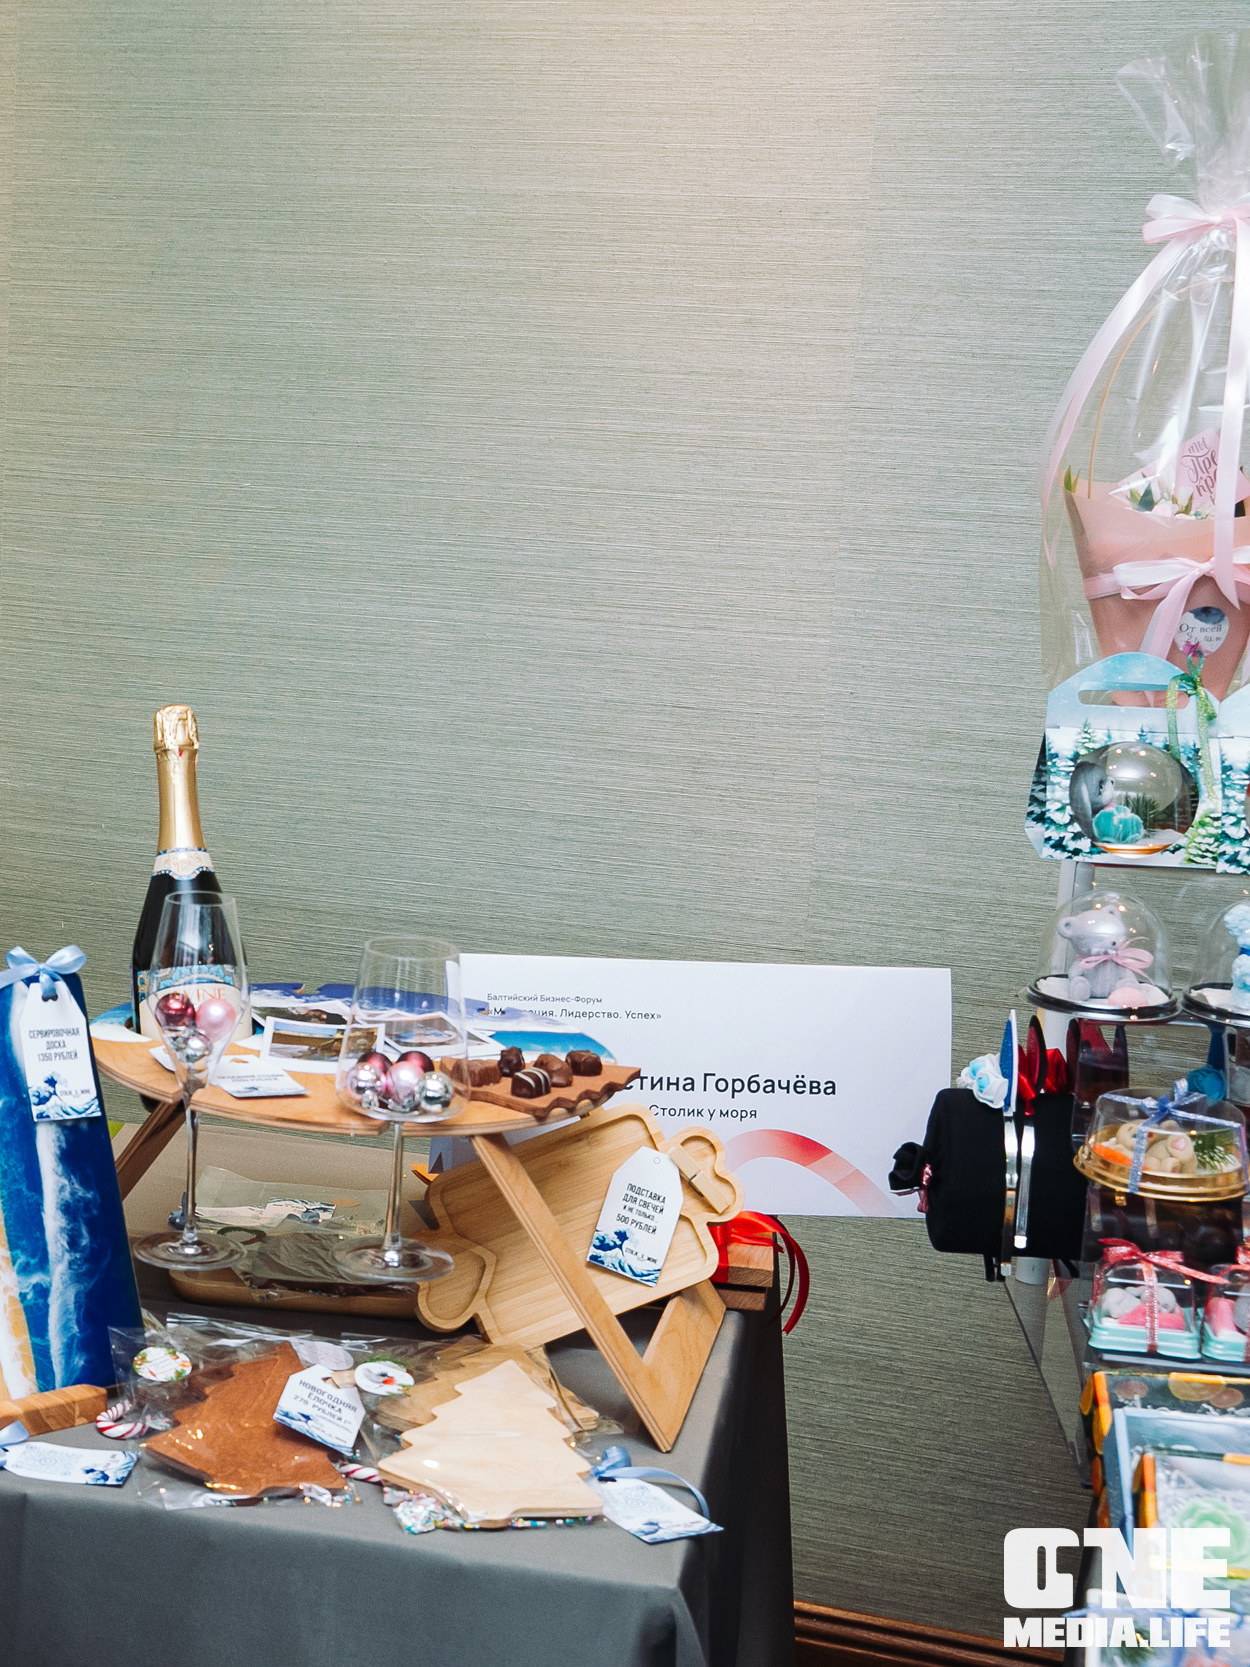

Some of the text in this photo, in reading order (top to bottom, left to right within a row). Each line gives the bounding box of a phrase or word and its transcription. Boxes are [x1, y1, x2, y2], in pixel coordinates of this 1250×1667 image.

[487, 993, 603, 1005] Балтийский Бизнес-Форум
[560, 1008, 622, 1021] Лидерство.
[625, 1010, 662, 1021] Успех»
[28, 1027, 80, 1039] СЕРВИРОВОЧНАЯ
[46, 1040, 66, 1051] ДОСКА
[38, 1049, 78, 1062] 1350 РУБЛЕЙ
[703, 1072, 837, 1099] Горбачёва
[649, 1104, 757, 1122] Столик у моря
[626, 1183, 666, 1204] ПОДСТАВКА
[622, 1193, 664, 1215] ДЛЯ СВЕЧЕЙ
[616, 1213, 657, 1235] 500 РУБЛЕЙ
[298, 1380, 357, 1412] НОВОГОДНЯЯ
[312, 1404, 342, 1421] РУБЛЕЙ
